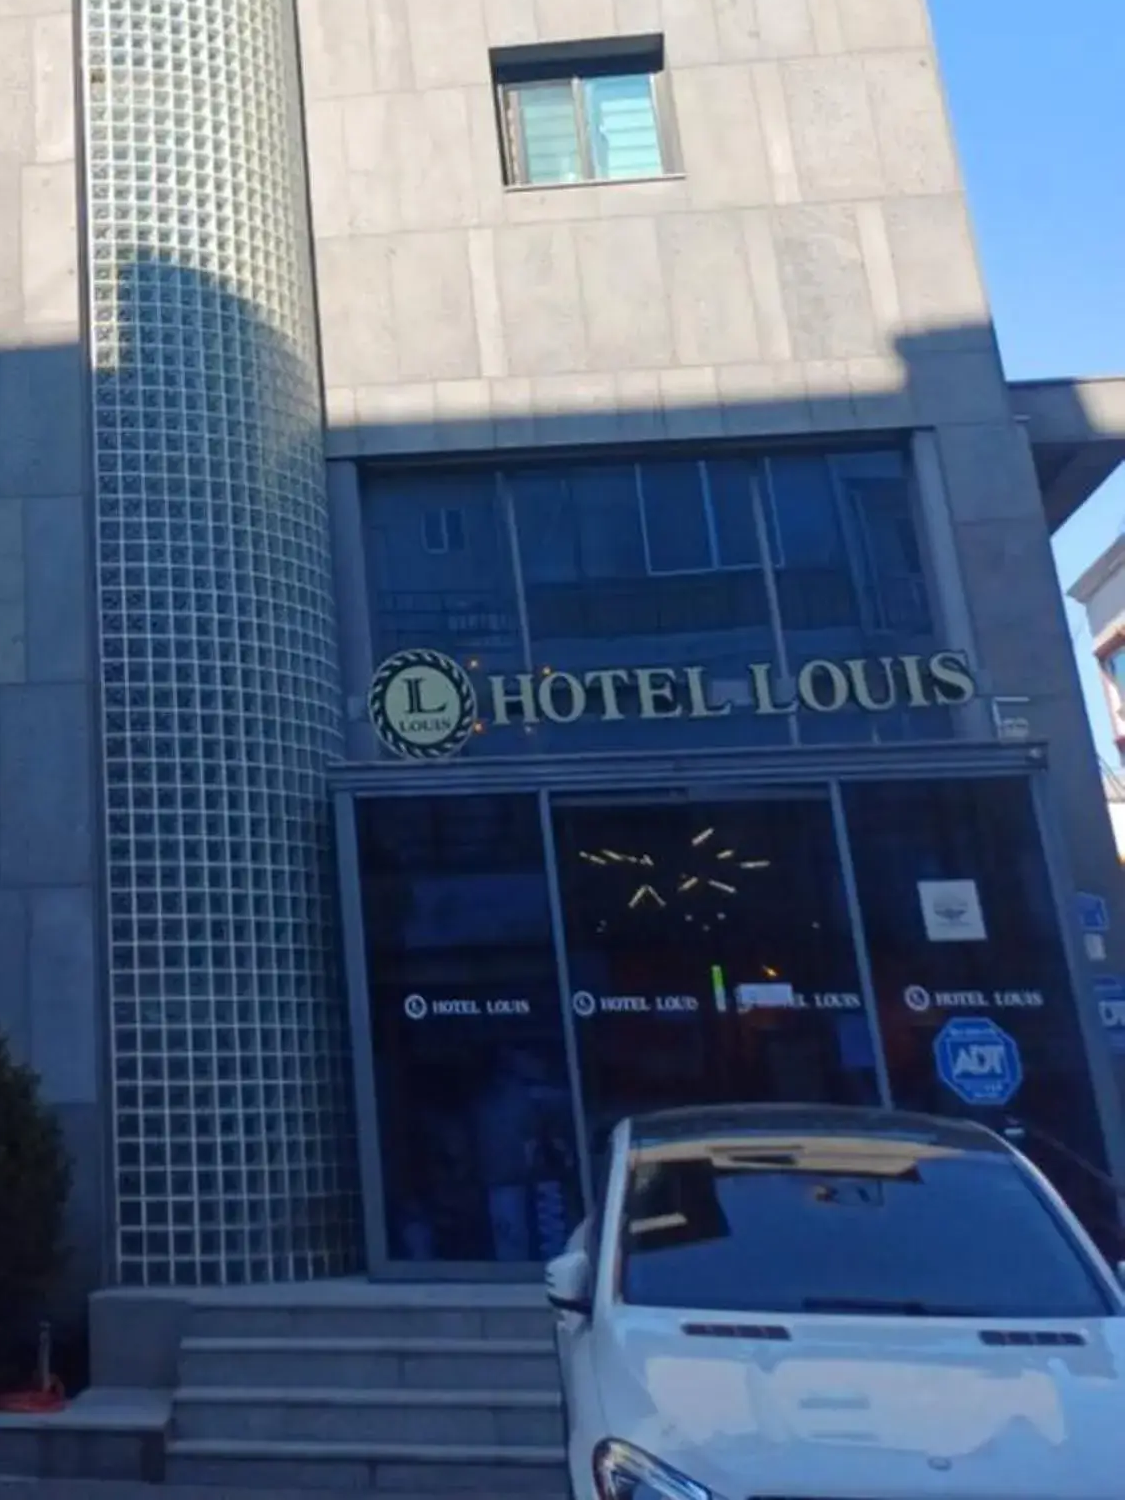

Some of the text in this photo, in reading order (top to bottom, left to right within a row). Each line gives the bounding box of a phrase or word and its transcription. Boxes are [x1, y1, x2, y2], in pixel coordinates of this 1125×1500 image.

[488, 651, 975, 726] HOTEL LOUIS
[397, 717, 452, 734] LOUIS
[600, 996, 651, 1011] HOTEL
[935, 991, 990, 1006] HOTEL
[432, 1000, 530, 1015] HOTEL LOUIS
[953, 1044, 1005, 1075] ADT
